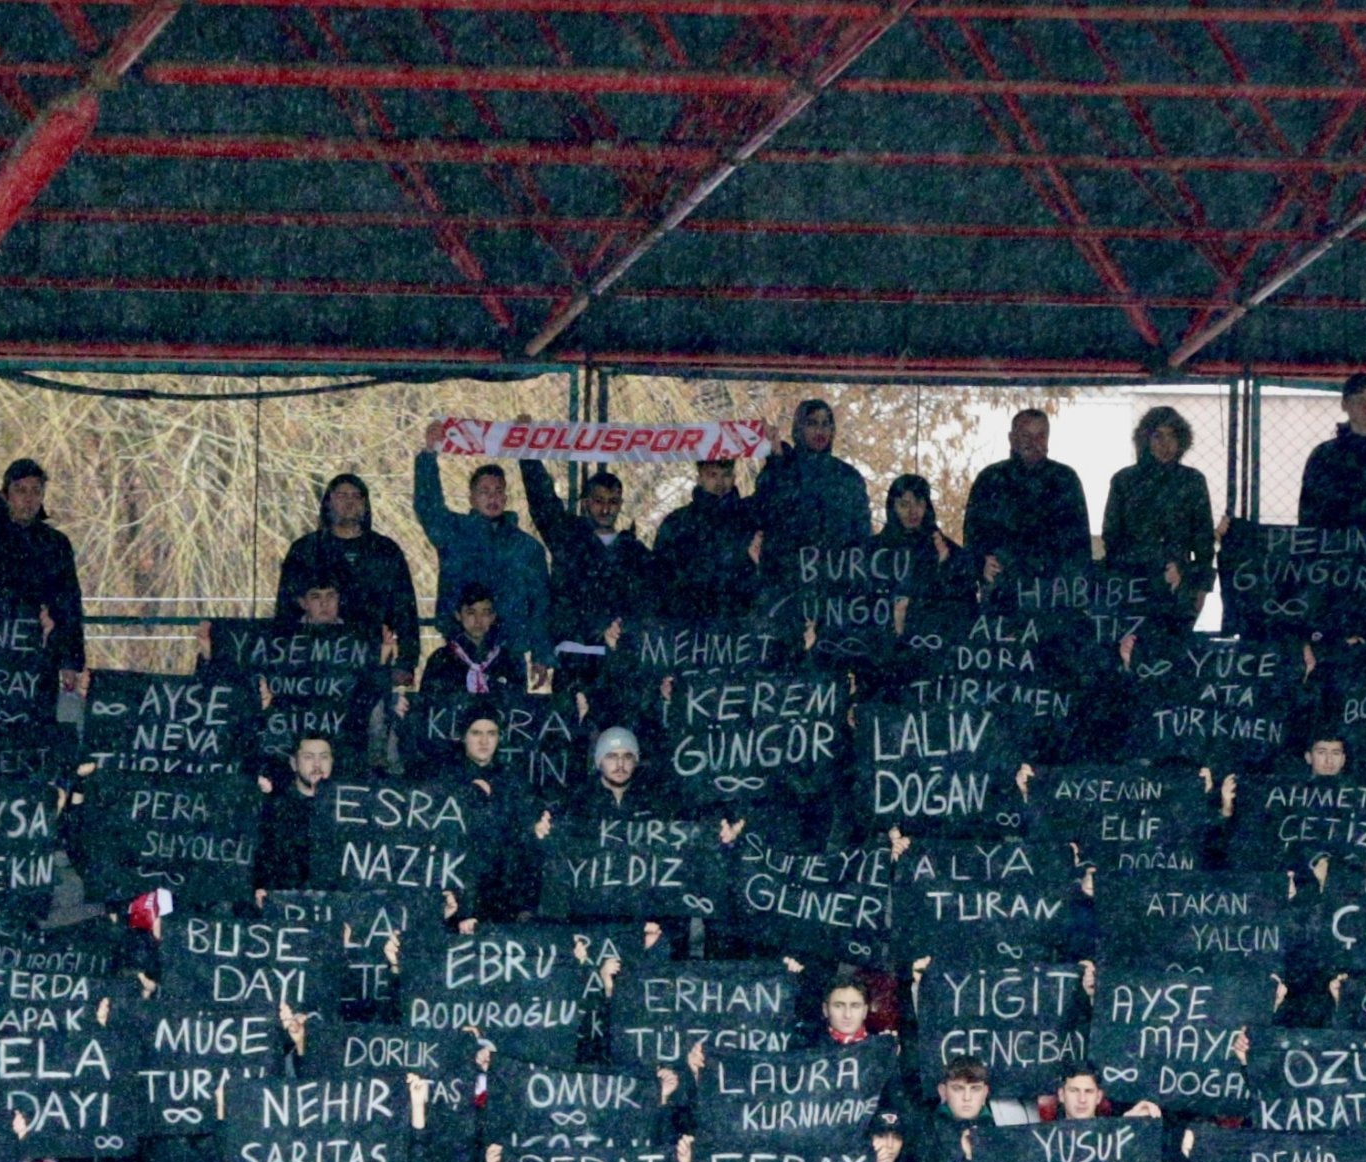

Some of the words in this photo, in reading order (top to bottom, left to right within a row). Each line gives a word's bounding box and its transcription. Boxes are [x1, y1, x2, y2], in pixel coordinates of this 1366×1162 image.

[501, 426, 706, 453] BOLUSPOR
[799, 546, 911, 583] BURCU
[969, 612, 1039, 644] ALA
[640, 629, 775, 667] MEHMET
[957, 647, 1036, 672] DORA
[1187, 642, 1277, 679] YÜCE
[686, 681, 836, 722] KEREM
[910, 674, 1071, 719] TÜRKMEN
[1199, 684, 1255, 707] ATA
[134, 723, 220, 755] NEVA
[267, 707, 345, 737] GİRAY
[426, 706, 571, 743] KRA
[1152, 705, 1284, 744] TÜRKMEN
[673, 719, 834, 777] GÜNGÖR
[131, 790, 209, 823] PERA
[336, 785, 467, 834] ESRA
[874, 765, 990, 818] DOĞAN
[1100, 807, 1163, 842] ELİF
[340, 841, 470, 891] NAZİK
[567, 858, 685, 891] YILDIZ
[913, 843, 1034, 883] ALYA
[743, 873, 883, 931] GÜNER
[926, 891, 1064, 922] TURAN
[1144, 892, 1249, 918] ATAKAN
[186, 916, 311, 963] BUSE
[1191, 923, 1280, 958] YALÇIN
[445, 940, 558, 990] EBRU
[212, 967, 307, 1004] DAYI
[641, 976, 783, 1015] ERHAN
[943, 966, 1079, 1021] YİĞİT
[410, 995, 585, 1030] BODUROĞLU
[343, 1036, 440, 1069] DORUK
[136, 1067, 268, 1104] TUR
[717, 1055, 861, 1097] LAURA
[1158, 1065, 1250, 1099] DOĞA
[6, 1090, 111, 1133] DAYI
